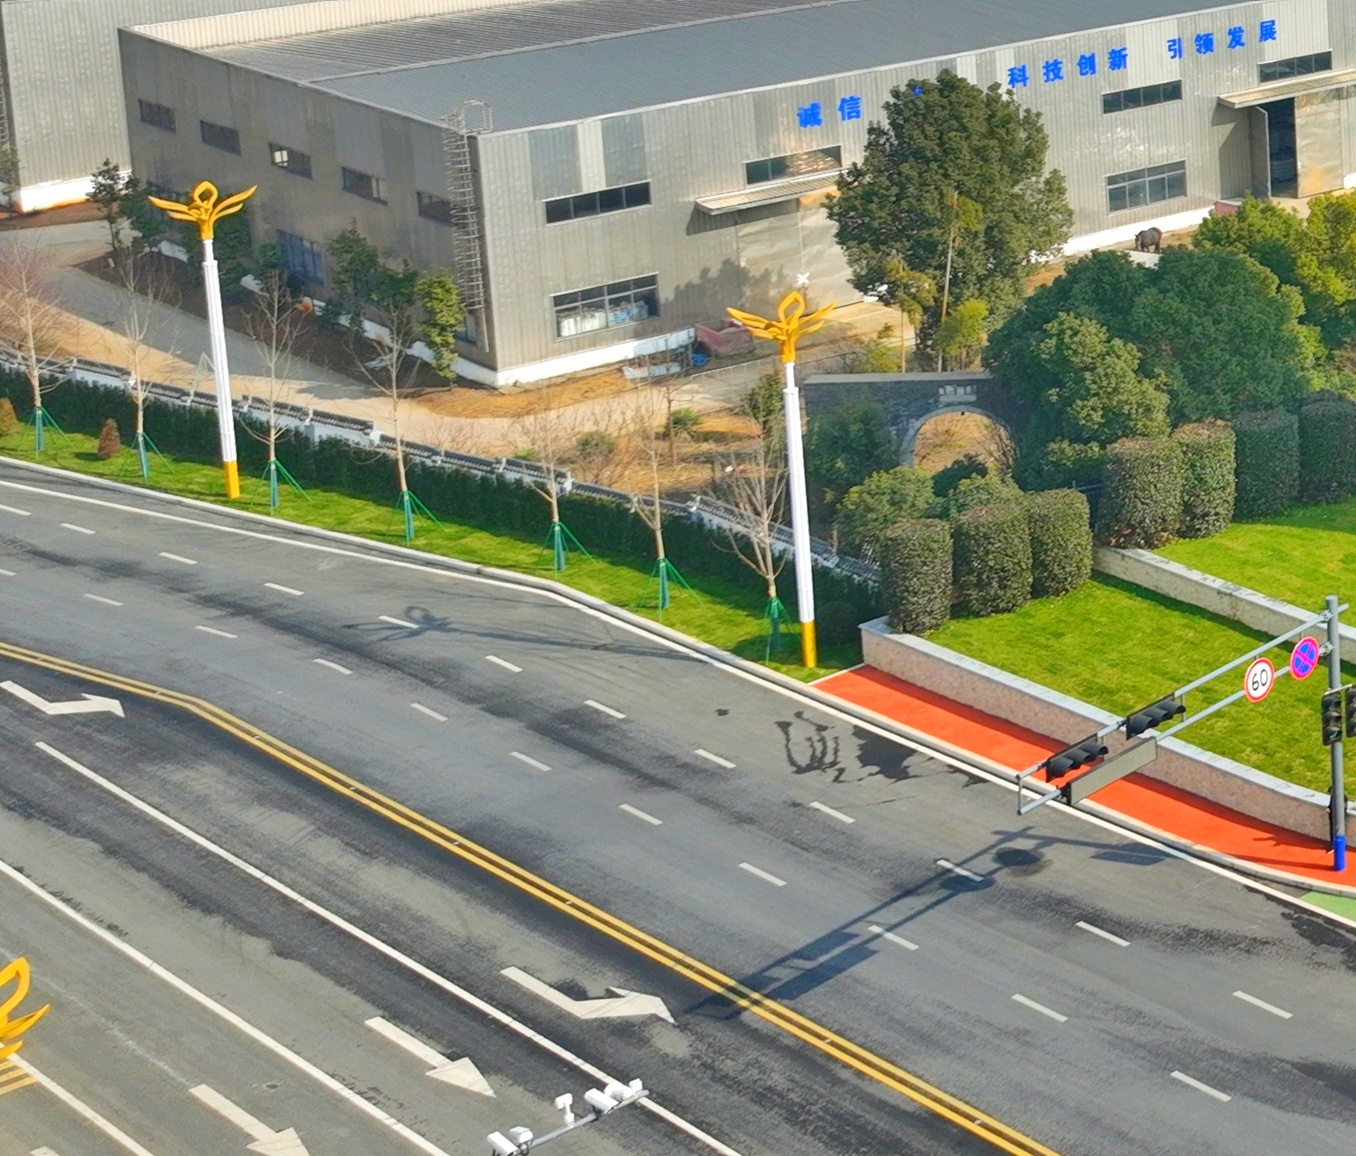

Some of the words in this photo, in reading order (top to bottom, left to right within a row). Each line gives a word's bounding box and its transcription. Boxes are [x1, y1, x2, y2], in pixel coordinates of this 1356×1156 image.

[1007, 47, 1129, 89] 科技创新
[1167, 19, 1277, 59] 引领发展
[1251, 669, 1268, 691] 60
